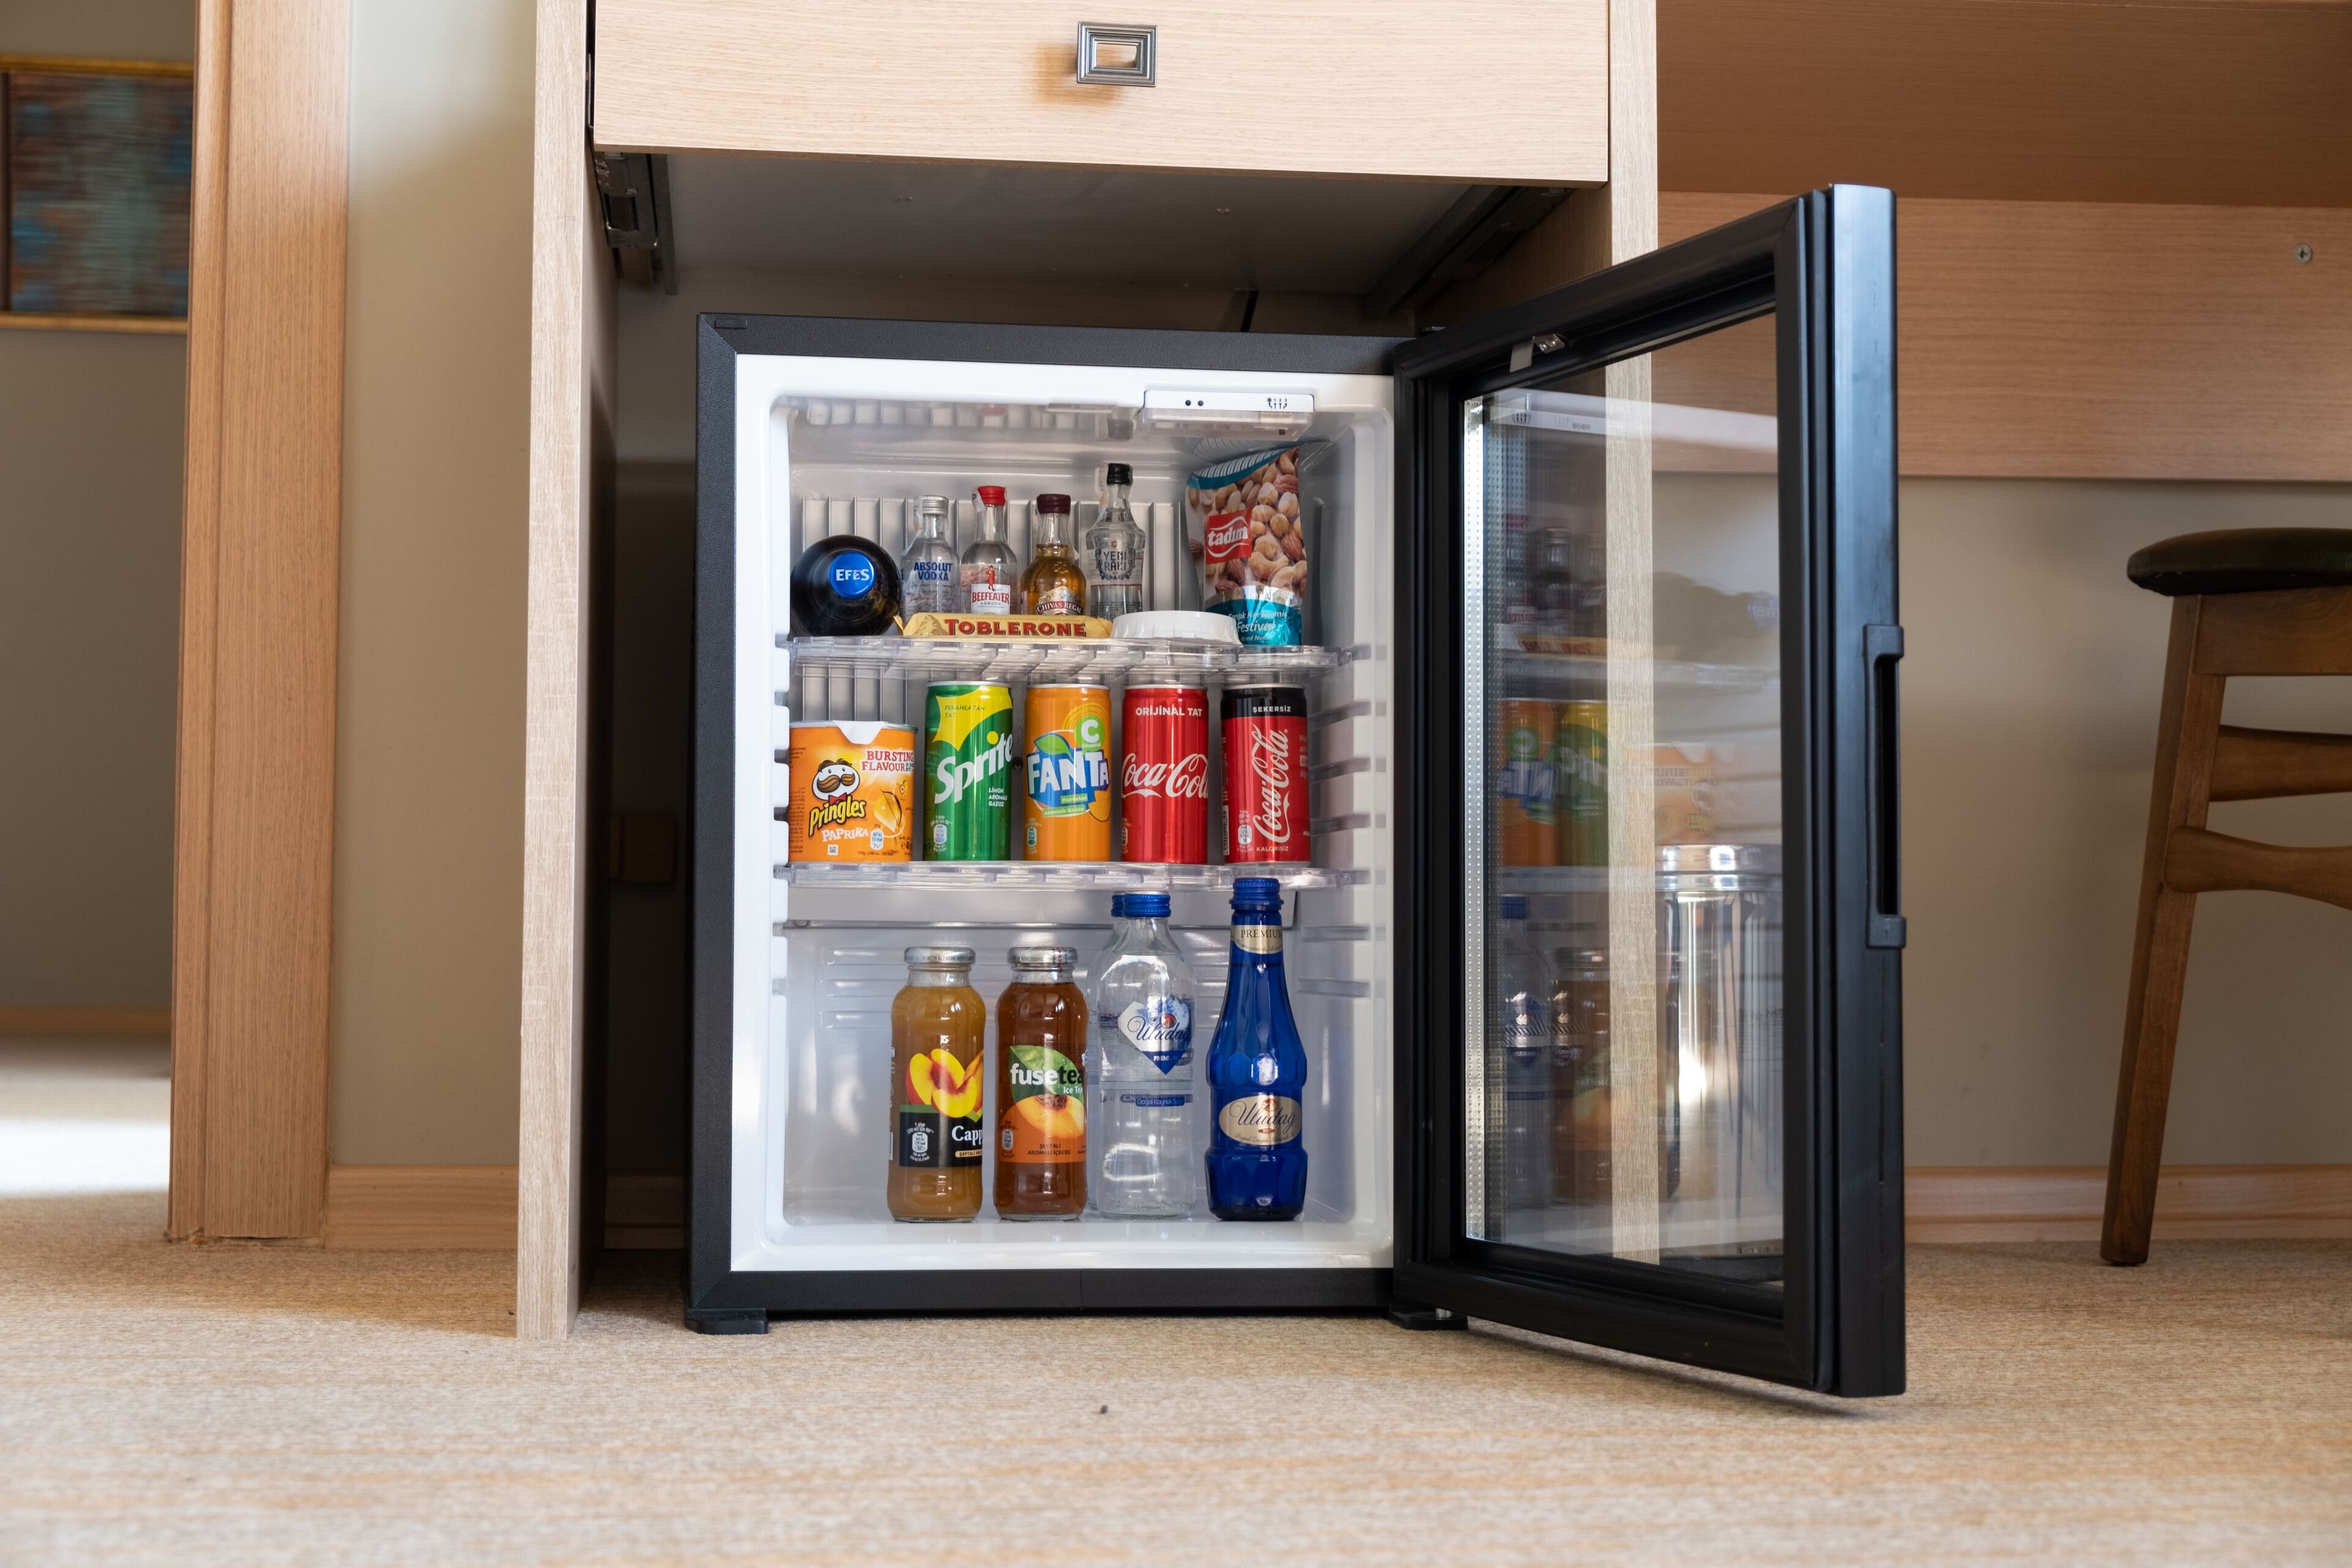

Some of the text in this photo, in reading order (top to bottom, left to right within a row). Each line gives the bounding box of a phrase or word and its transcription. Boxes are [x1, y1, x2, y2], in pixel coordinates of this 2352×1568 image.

[1207, 526, 1248, 546] tadım
[1103, 549, 1126, 561] YENİ
[914, 562, 954, 571] ABSOLUT
[1104, 561, 1126, 571] RAKI
[835, 568, 870, 581] EFES
[918, 571, 949, 581] VODKA
[972, 592, 1010, 605] BEEFEATER
[1036, 601, 1063, 613] CHIVAS
[1064, 602, 1082, 613] REGAL
[944, 619, 1087, 636] TOBLERONE
[1136, 705, 1202, 717] ORİJİNAL TAT
[1253, 705, 1291, 714] ŞEKERSİZ
[1081, 719, 1099, 743] C
[866, 750, 914, 762] BURSTING
[861, 761, 905, 772] FLAVOUR
[934, 731, 1012, 804] Sprite
[1027, 750, 1109, 795] FANTA
[809, 796, 867, 837] Pringles
[821, 827, 869, 842] PAPRIKA
[1011, 1063, 1084, 1085] fusetea
